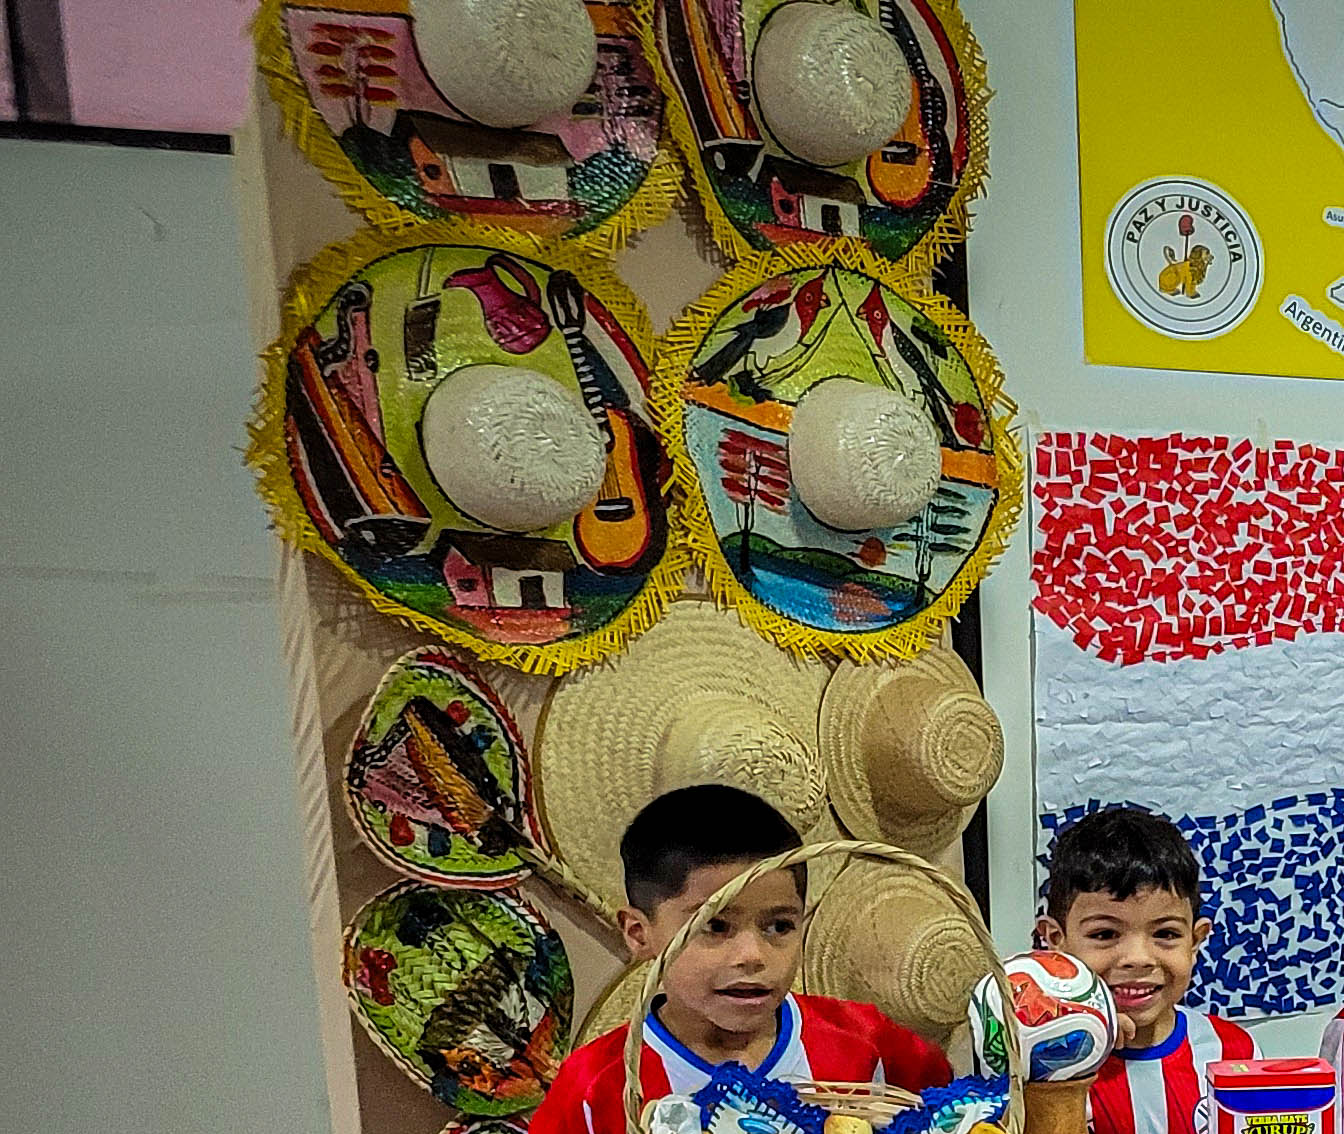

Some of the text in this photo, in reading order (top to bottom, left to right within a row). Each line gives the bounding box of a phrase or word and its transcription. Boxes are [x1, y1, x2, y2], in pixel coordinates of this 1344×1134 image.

[1126, 196, 1243, 263] PAZ Y JUSTICIA
[1246, 1113, 1308, 1125] YERBA MATE
